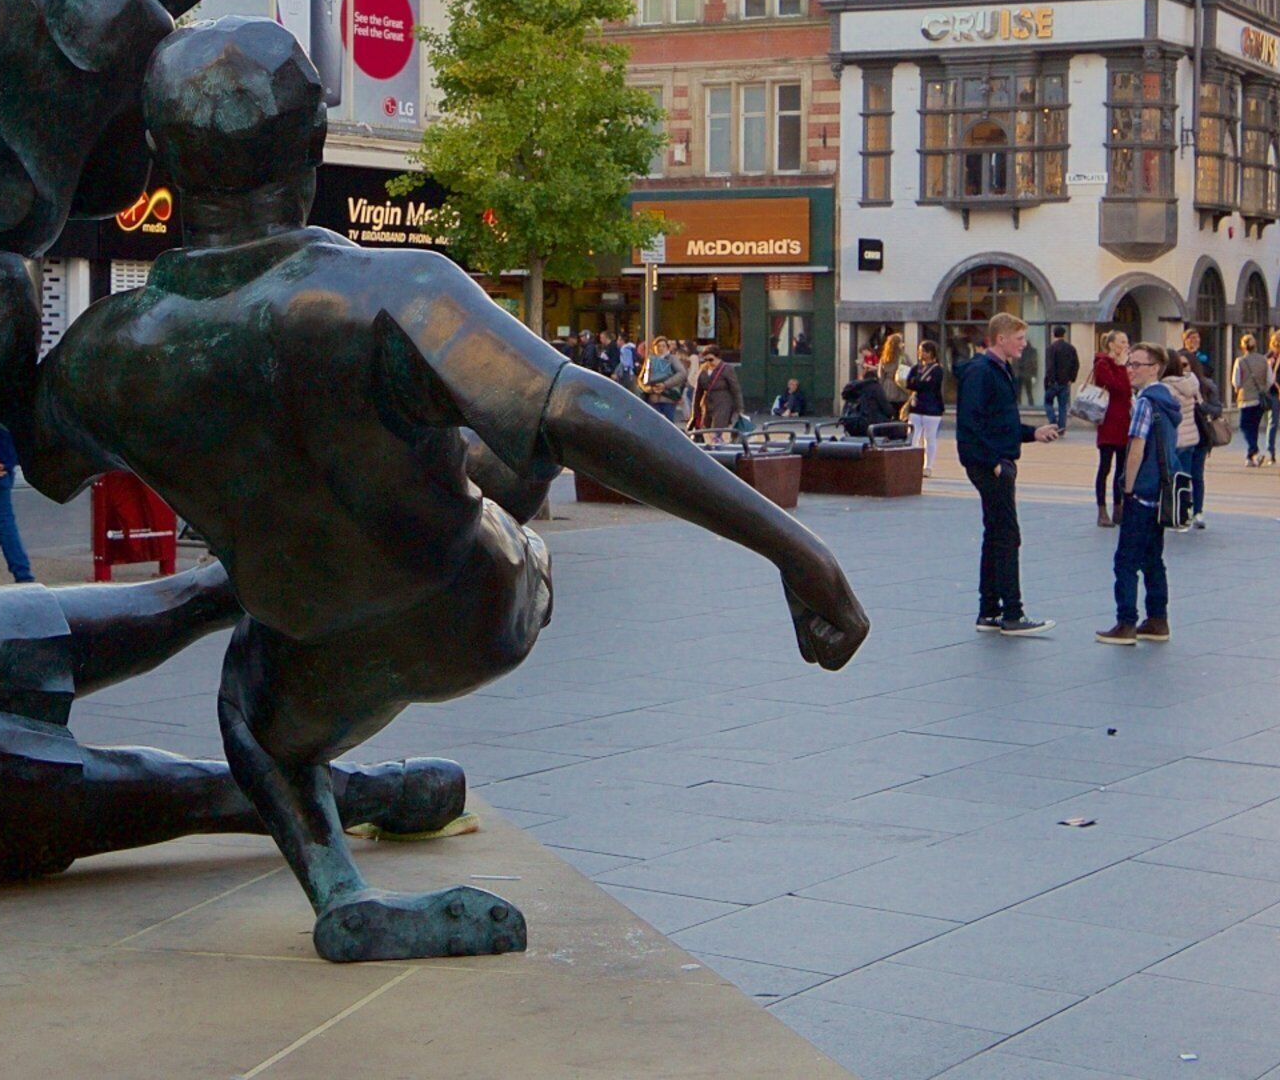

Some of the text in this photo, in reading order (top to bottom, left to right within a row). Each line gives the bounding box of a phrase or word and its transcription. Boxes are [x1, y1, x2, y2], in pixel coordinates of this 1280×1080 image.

[354, 11, 404, 29] See the Great
[921, 7, 1054, 42] CRUISE
[354, 23, 405, 42] Feel the Great
[398, 101, 414, 117] LG
[347, 197, 402, 231] Virgin
[348, 230, 359, 240] TV
[361, 231, 407, 243] BROADBAND
[687, 238, 802, 257] McDonald's
